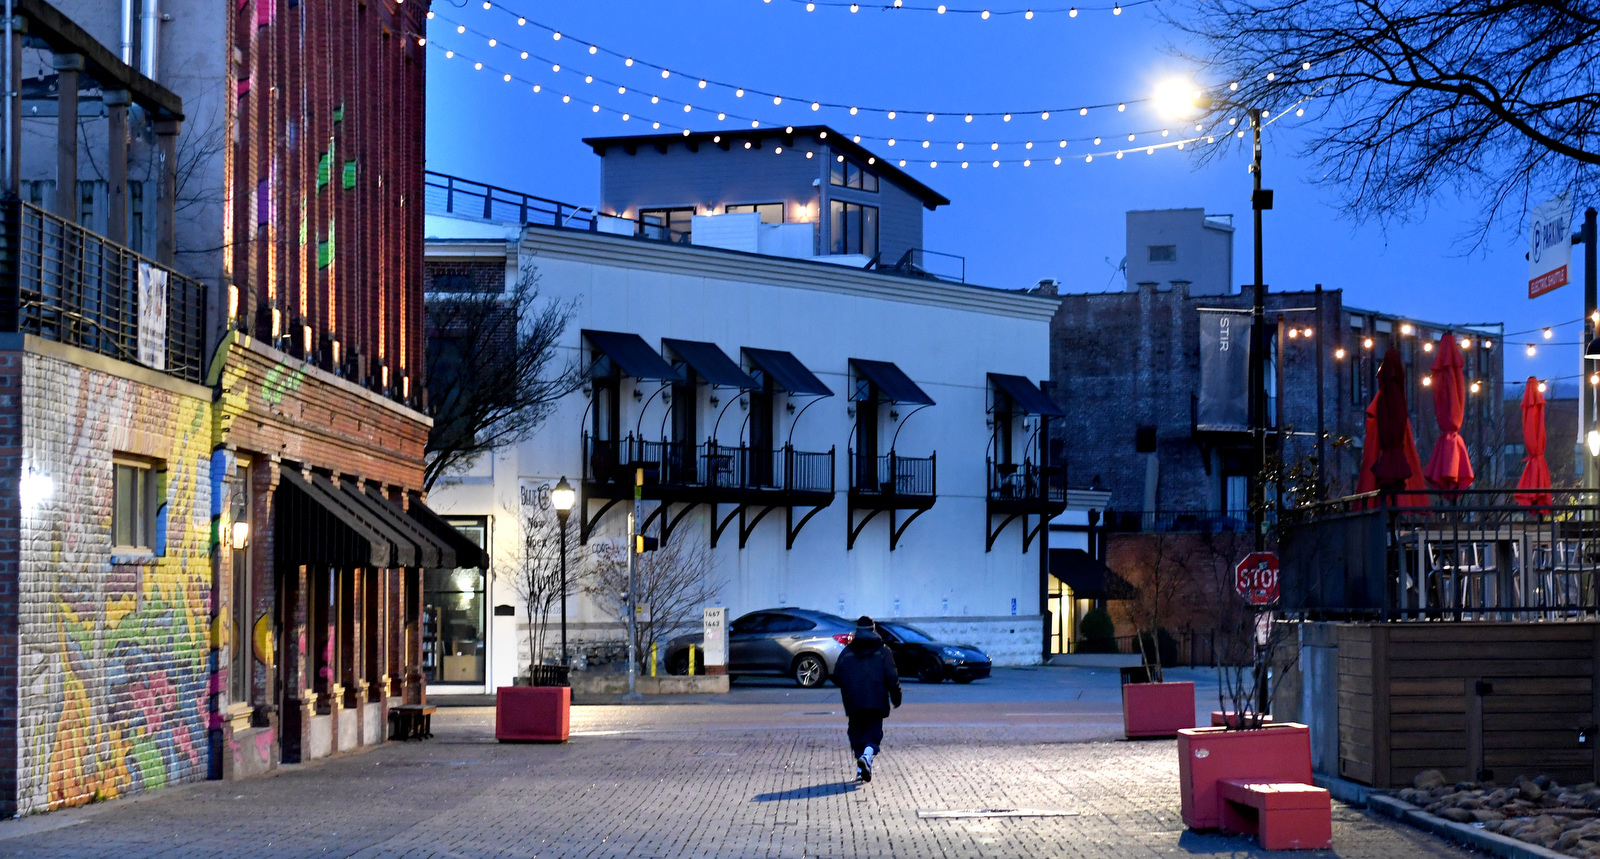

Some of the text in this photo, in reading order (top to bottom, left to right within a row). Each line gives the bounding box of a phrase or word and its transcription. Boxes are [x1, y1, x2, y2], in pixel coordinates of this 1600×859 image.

[1543, 217, 1564, 250] PARKING
[1530, 268, 1565, 295] ELECTRIC SHUTTLE
[1220, 317, 1230, 352] STIR
